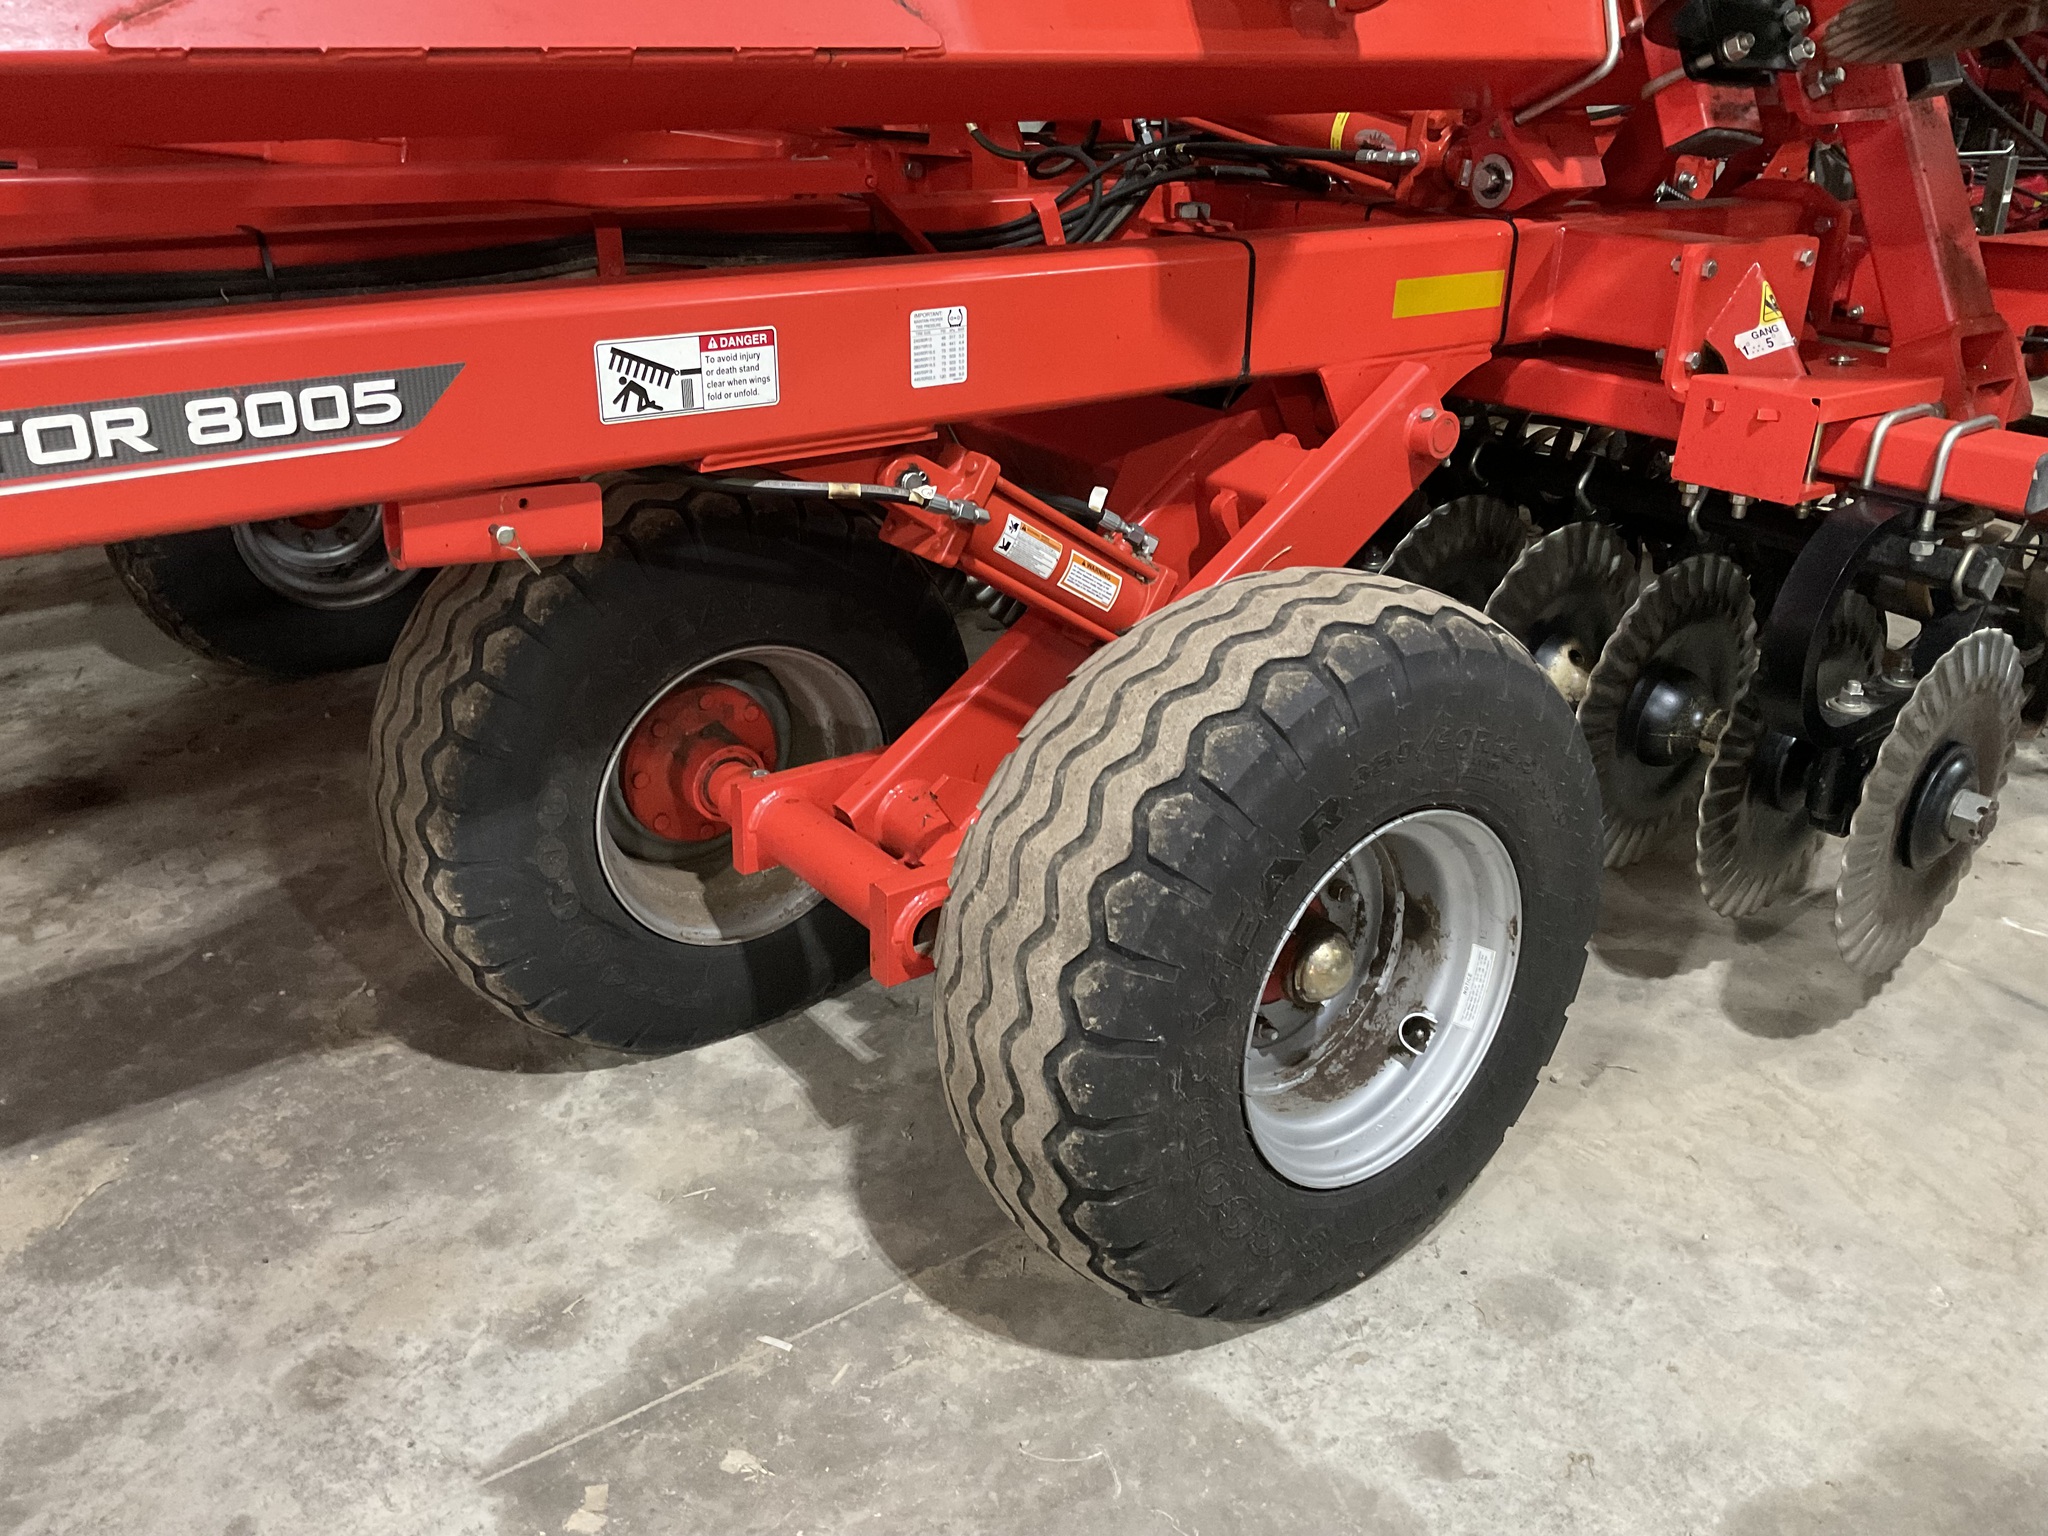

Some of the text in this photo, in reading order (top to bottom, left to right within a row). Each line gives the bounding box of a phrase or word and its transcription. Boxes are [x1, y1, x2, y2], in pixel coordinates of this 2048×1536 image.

[1751, 324, 1779, 340] GANG
[719, 334, 767, 348] DANGER
[705, 351, 761, 364] To avoid injury
[716, 366, 737, 376] death
[739, 363, 760, 374] stand
[706, 375, 771, 389] clear when wings
[707, 388, 760, 401] fold or unfold.
[0, 379, 403, 466] OR 8005
[1087, 562, 1111, 580] WARNING
[1463, 973, 1472, 995] NOTICE
